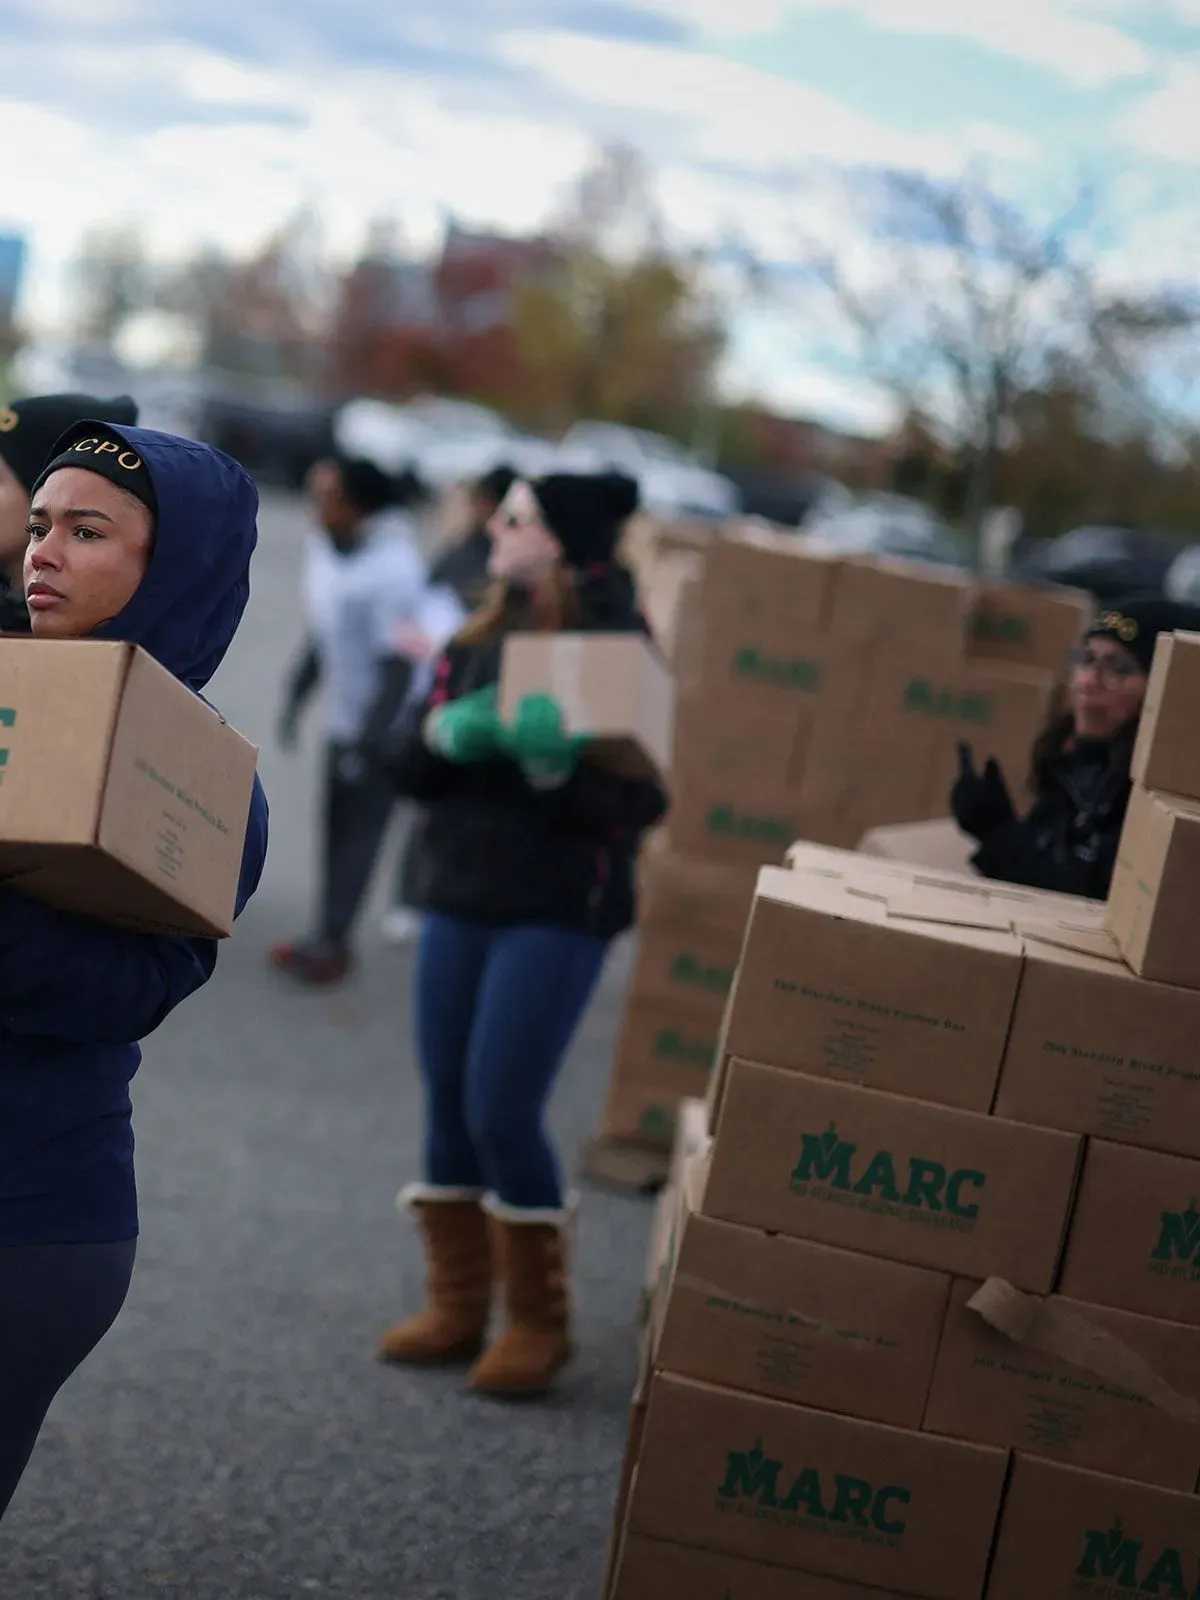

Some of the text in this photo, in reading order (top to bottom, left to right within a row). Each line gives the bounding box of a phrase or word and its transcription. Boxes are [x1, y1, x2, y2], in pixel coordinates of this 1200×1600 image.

[67, 437, 143, 471] CPO
[791, 1130, 987, 1219] MARC
[717, 1446, 912, 1535] MARC
[1075, 1527, 1200, 1600] MA
